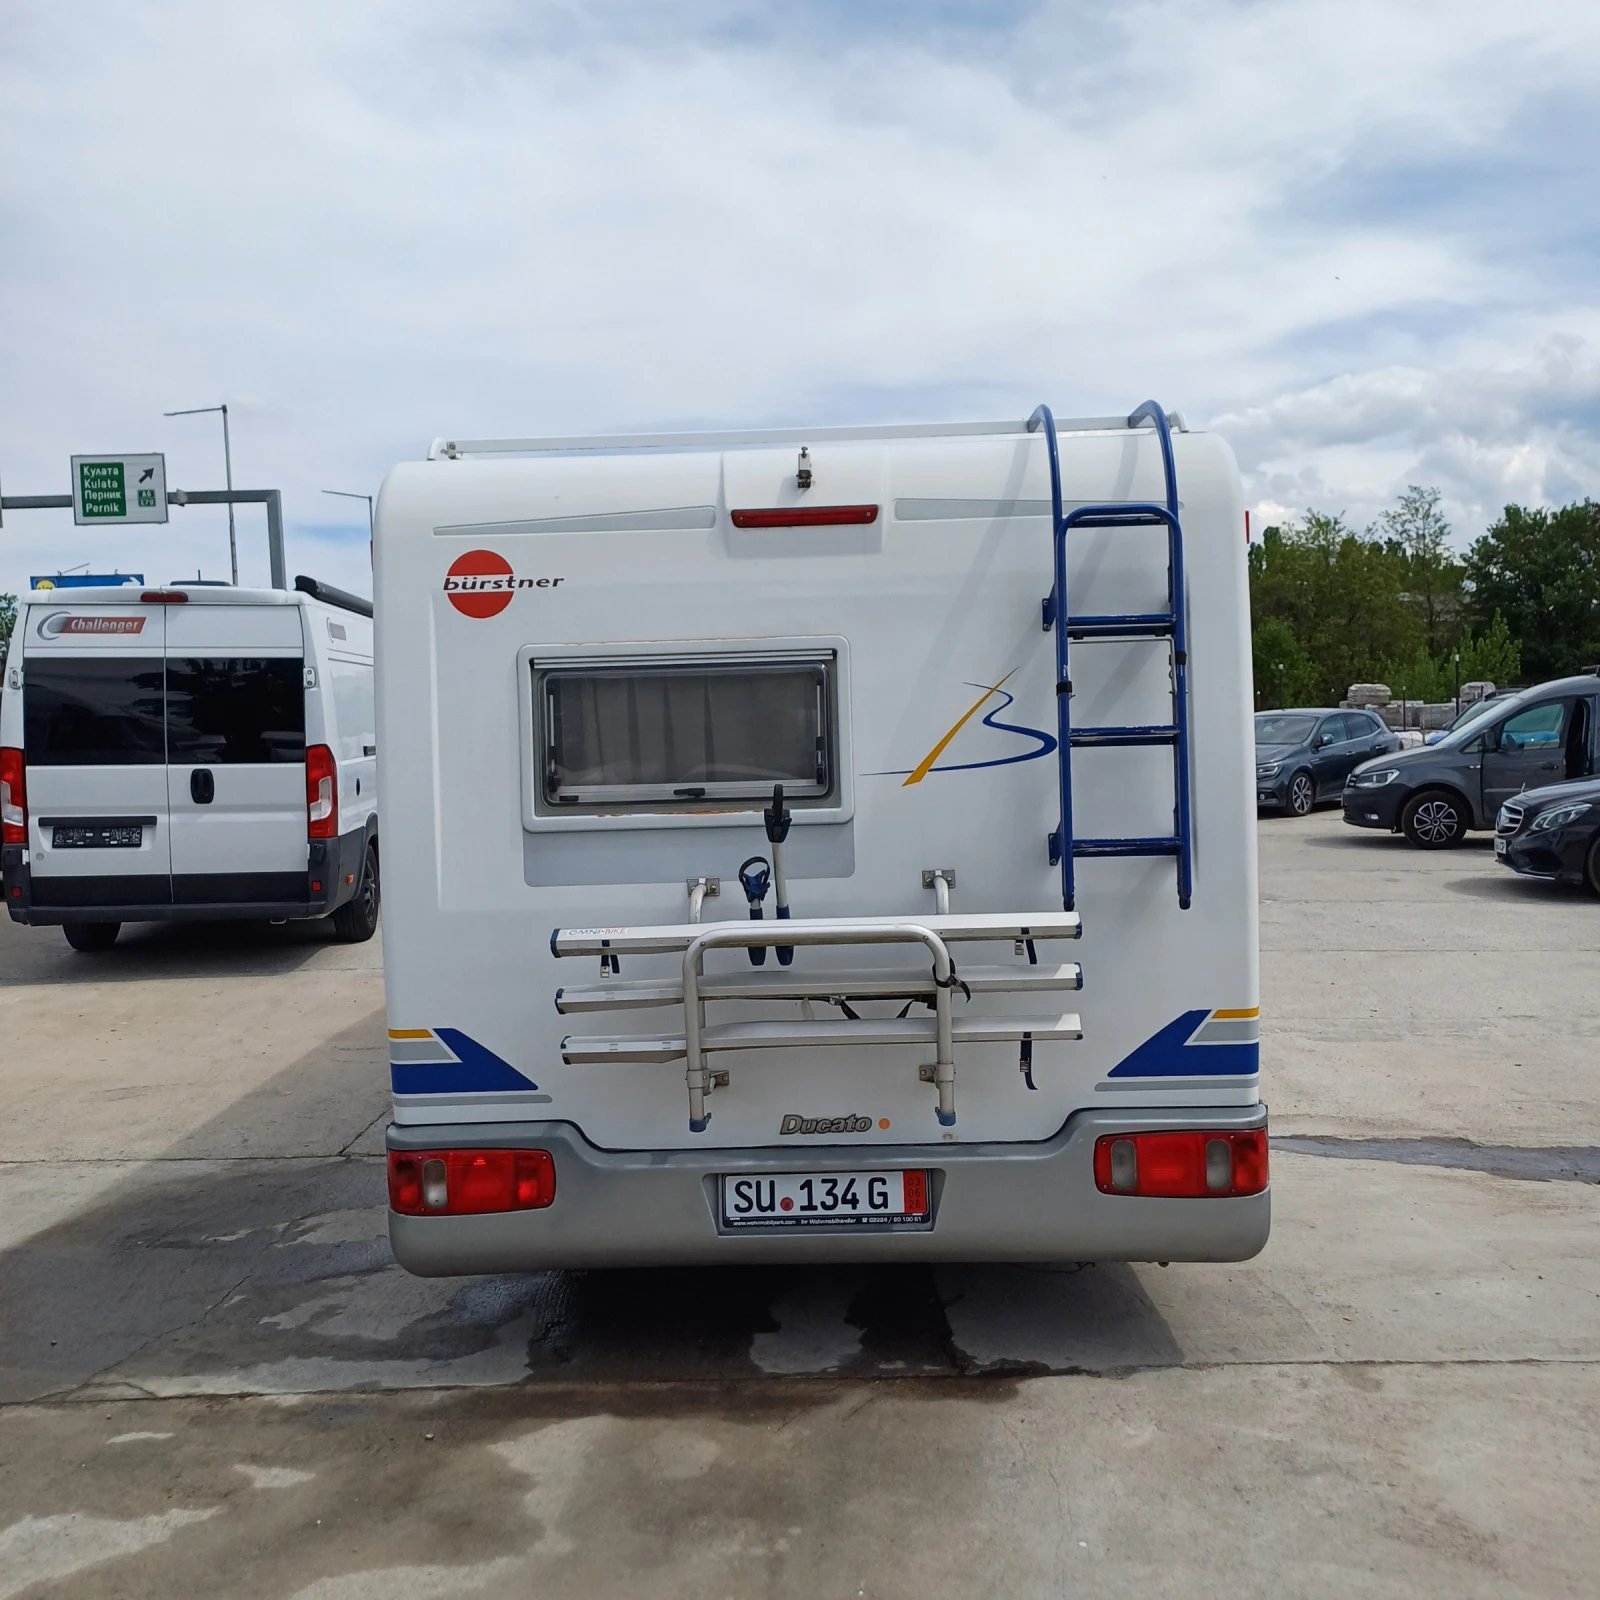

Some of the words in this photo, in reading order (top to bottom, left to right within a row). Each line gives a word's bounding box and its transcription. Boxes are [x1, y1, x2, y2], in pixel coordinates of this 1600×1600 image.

[83, 466, 119, 478] Кулата
[84, 479, 118, 489] Kulata
[84, 490, 122, 502] Перник
[85, 502, 120, 513] Pernik
[443, 575, 565, 591] bürstner
[71, 618, 139, 633] Challenger
[779, 1113, 873, 1135] Ducato
[733, 1179, 776, 1213] SU
[799, 1177, 860, 1212] 134
[868, 1177, 889, 1210] G
